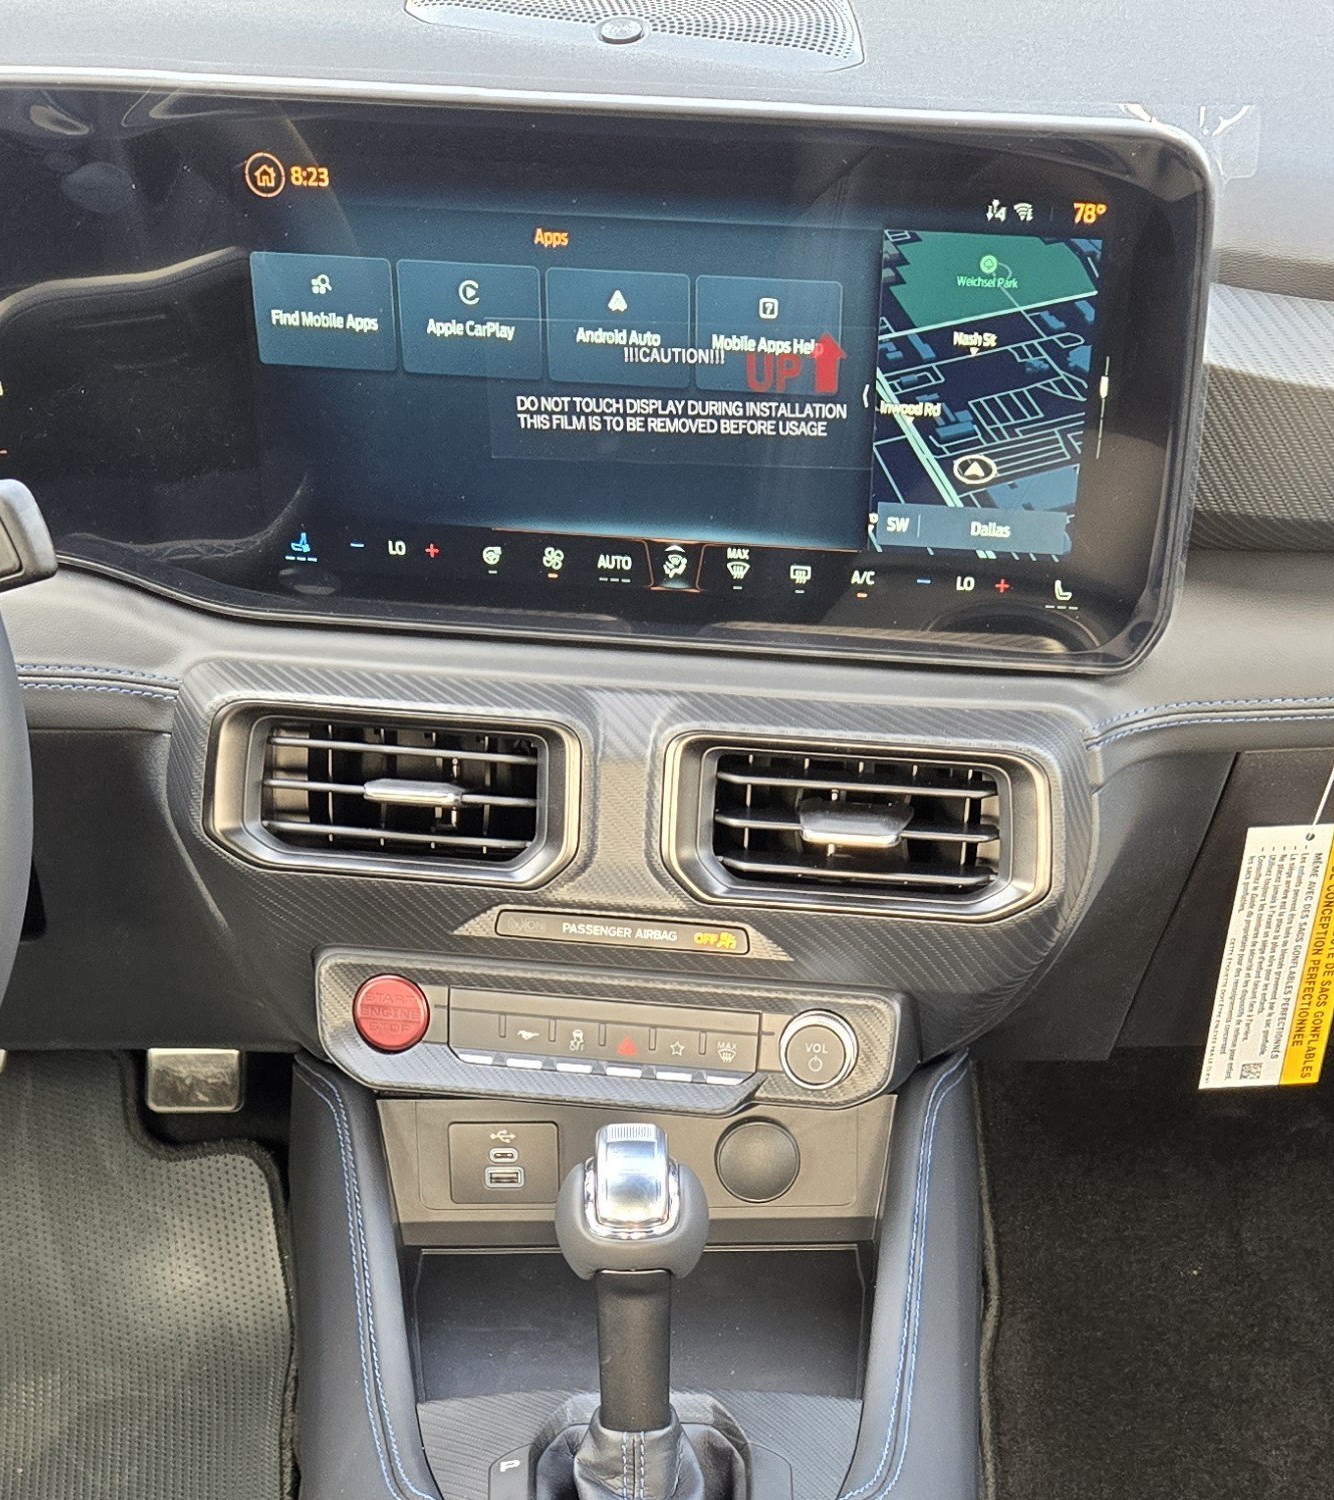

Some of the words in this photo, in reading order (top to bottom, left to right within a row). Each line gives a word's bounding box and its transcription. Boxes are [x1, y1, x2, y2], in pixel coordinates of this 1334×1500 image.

[290, 166, 330, 187] 8:23
[1074, 202, 1108, 224] 78°
[534, 227, 569, 248] Apps
[997, 277, 1019, 289] Park
[270, 309, 300, 328] Find
[301, 311, 344, 329] Mobile
[346, 313, 379, 333] Apps
[426, 318, 464, 337] Apple
[465, 320, 516, 342] CarPlay
[575, 327, 627, 345] Android
[628, 329, 661, 347] Auto
[711, 333, 755, 352] Mobile
[756, 335, 791, 354] Apps
[953, 331, 981, 347] Nash
[982, 332, 998, 347] St
[745, 351, 802, 394] UP
[516, 395, 538, 412] DO
[540, 395, 573, 412] NOT
[574, 396, 624, 414] TOUCH
[625, 398, 685, 415] DISPLAY
[687, 399, 743, 417] DURING
[745, 401, 848, 419] INSTALLATION
[880, 400, 921, 416] Inwood
[923, 402, 942, 417] Rd
[517, 413, 550, 430] THIS
[552, 414, 587, 431] FILM
[589, 415, 602, 431] IS
[603, 416, 623, 432] TO
[626, 416, 645, 433] BE
[647, 417, 718, 434] REMOVED
[720, 418, 776, 435] BEFORE
[778, 420, 827, 437] USAGE
[886, 516, 910, 533] SW
[970, 521, 1011, 538] Dallas
[388, 540, 406, 556] LO
[727, 548, 749, 560] MAX
[597, 554, 632, 571] AUTO
[851, 570, 875, 586] A/C
[956, 576, 975, 592] LO
[1309, 852, 1325, 877] MÊME
[1304, 880, 1316, 900] AVEC
[1300, 903, 1311, 919] DES
[562, 922, 632, 939] PASSENGER
[634, 928, 678, 943] AIRBAG
[693, 932, 719, 946] OFF
[1294, 921, 1307, 942] SACS
[1283, 945, 1301, 995] GONFLABLES
[1322, 962, 1334, 976] DE
[366, 992, 415, 1003] START
[1315, 980, 1331, 1007] SACS
[1291, 959, 1322, 1046] PERFECTIONNÉE
[360, 1006, 420, 1021] ENGINE
[369, 1022, 412, 1033] STOP
[1269, 997, 1291, 1059] PERFECTIONNÉS
[569, 1041, 585, 1052] OFF
[717, 1041, 738, 1051] MAX
[805, 1042, 828, 1054] VOL
[1299, 1011, 1325, 1078] GONFLABLES
[499, 1459, 521, 1473] P
